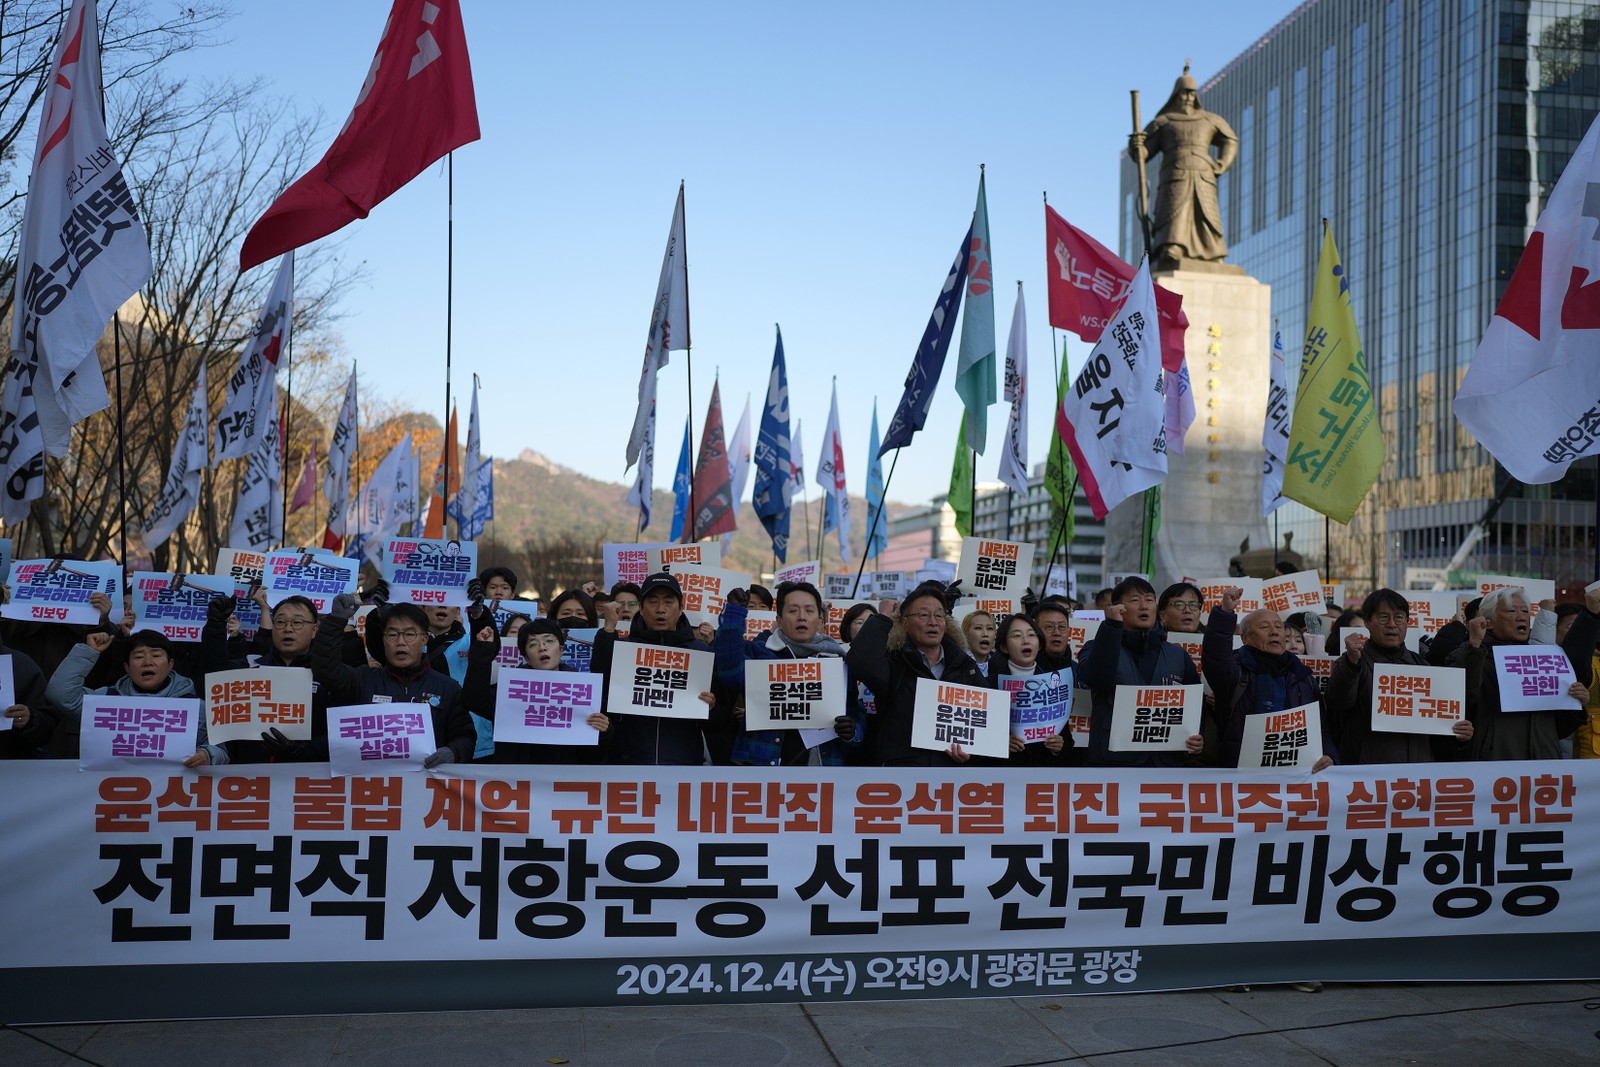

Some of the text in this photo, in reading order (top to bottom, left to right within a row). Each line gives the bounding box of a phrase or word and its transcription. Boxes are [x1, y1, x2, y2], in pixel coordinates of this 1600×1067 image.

[618, 551, 647, 562] 위헌적
[660, 547, 701, 565] 내란죄
[978, 541, 1019, 560] 내란죄
[976, 557, 1017, 576] 윤석열
[31, 571, 100, 590] 윤석열을
[273, 577, 347, 595] 탄핵하라!
[392, 570, 466, 587] 체포하라!
[974, 572, 1008, 591] 파면!
[410, 589, 446, 602] 진보당
[1262, 581, 1298, 600] 위헌적
[31, 606, 70, 620] 진보당
[163, 625, 200, 640] 진보당
[635, 647, 690, 672] 내란죄
[1504, 654, 1571, 675] 국민주권
[634, 667, 689, 691] 윤석열
[769, 662, 822, 682] 내란죄
[210, 680, 272, 704] 위헌적
[507, 680, 593, 706] 국민주권
[769, 682, 823, 701] 윤석열
[1378, 675, 1431, 697] 위헌적
[1520, 676, 1560, 697] 실현!
[632, 687, 674, 709] 파면!
[937, 685, 988, 709] 내란죄
[1136, 689, 1185, 707] 내란죄
[211, 703, 306, 727] 계엄 규탄!
[524, 705, 573, 729] 실현!
[769, 703, 811, 721] 파면!
[936, 704, 988, 729] 윤석열
[1134, 707, 1183, 726] 윤석열
[1377, 696, 1461, 720] 계엄 규탄!
[93, 707, 188, 733] 국민주권
[339, 713, 426, 739] 국민주권
[1265, 710, 1307, 733] 내란죄
[111, 733, 167, 758] 실현!
[934, 725, 976, 746] 파면!
[1131, 726, 1171, 744] 파면!
[1263, 728, 1308, 751] 윤석열
[359, 738, 411, 761] 실현!
[1260, 749, 1298, 768] 파면!
[95, 773, 1577, 834] 윤석열 불법 계엄 규탄 내란죄 윤석열 퇴진 국민주권 실현을 위한
[93, 828, 1575, 943] 전면적 저항운동 선포 전국민 비상 행동
[616, 948, 1142, 996] 2024.12.4(수) 오전9시 광화문 광장
